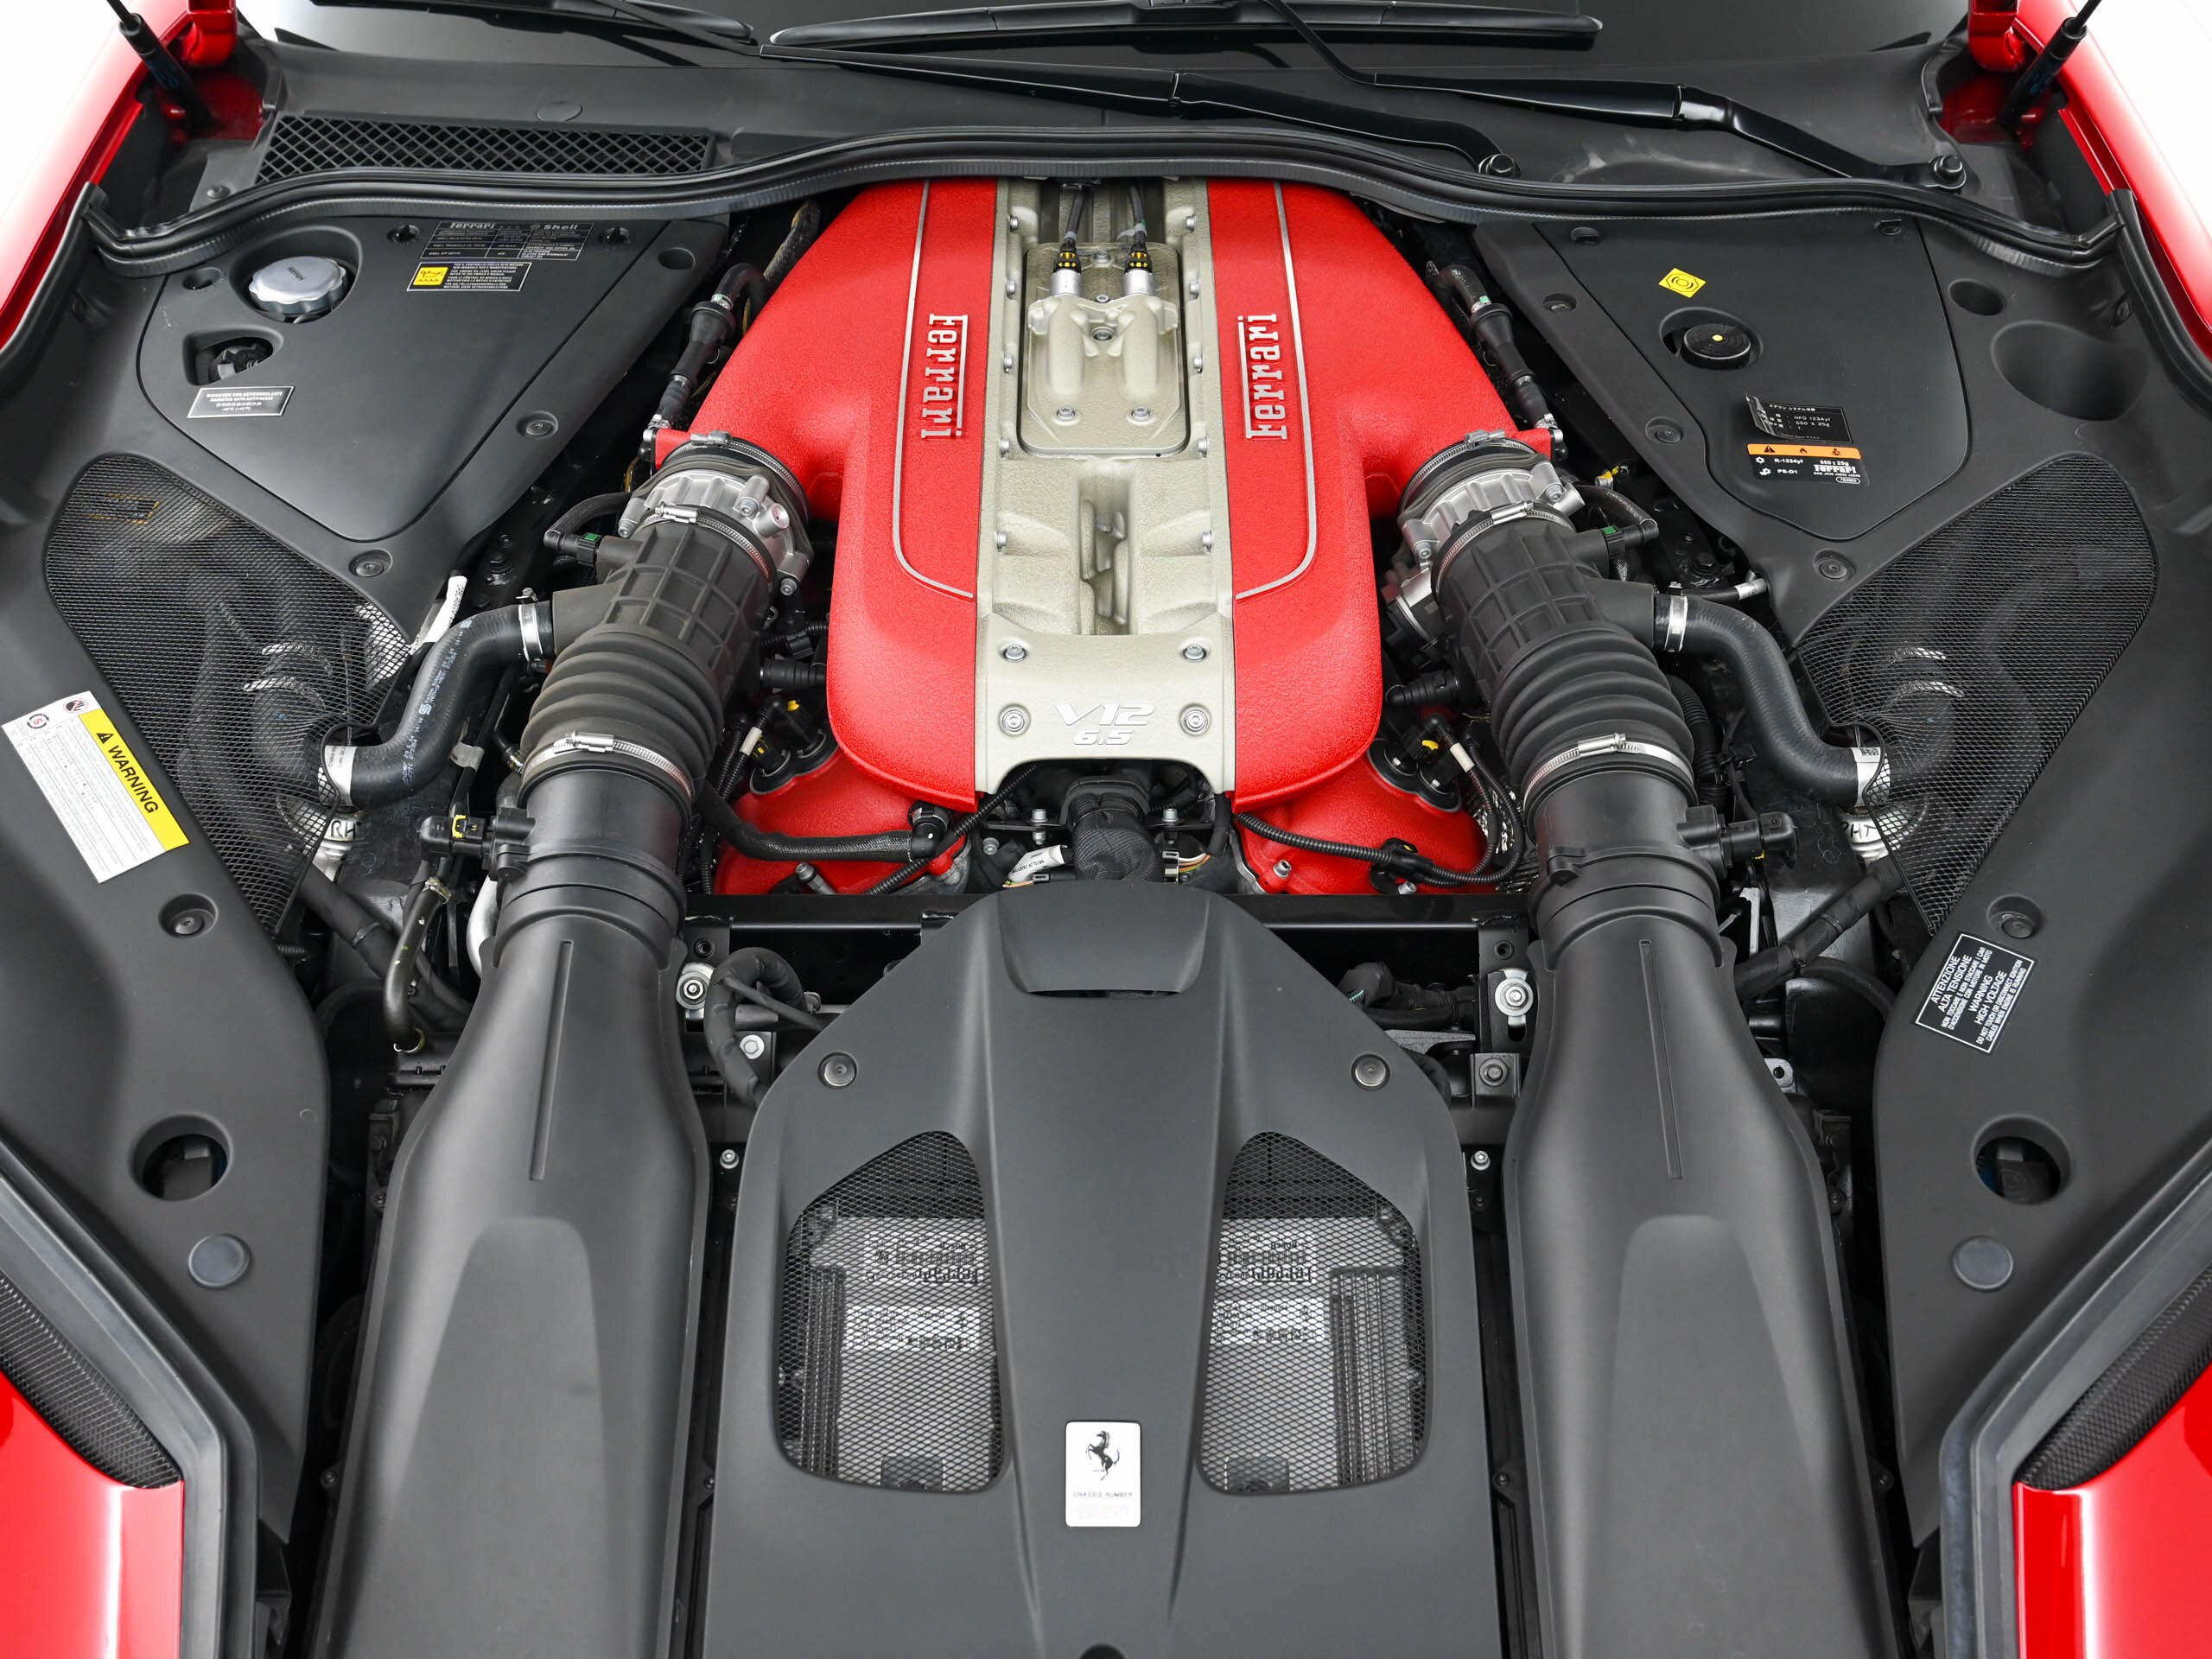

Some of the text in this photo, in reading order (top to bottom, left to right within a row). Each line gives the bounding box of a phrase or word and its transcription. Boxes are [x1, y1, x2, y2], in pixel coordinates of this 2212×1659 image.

[920, 314, 969, 439] Ferrari
[1237, 313, 1288, 440] Ferrari
[1814, 464, 1857, 474] Ferrari
[1055, 703, 1155, 726] V12
[1074, 729, 1133, 745] 6.5
[108, 745, 159, 814] WARNING
[1981, 950, 1993, 963] MOTO
[1929, 955, 1961, 1003] ATTENZIONE
[1936, 954, 1972, 1012] ALTA TENSIONE
[1941, 1015, 1950, 1027] NON
[1946, 995, 1961, 1016] TOCCARE
[1958, 981, 1968, 992] NON
[1964, 959, 1980, 982] STACCARE
[1963, 987, 1974, 998] CON
[1967, 974, 1993, 1013] WARNING
[1968, 969, 1983, 988] MOTORE
[1974, 969, 2007, 1025] HIGH VOLTAGE
[1976, 1035, 1984, 1044] DO
[1984, 1011, 1997, 1027] TOUCH
[1985, 1023, 1999, 1041] CABLES
[1993, 1009, 2005, 1024] WHEN
[2000, 993, 2013, 1010] ENGINE
